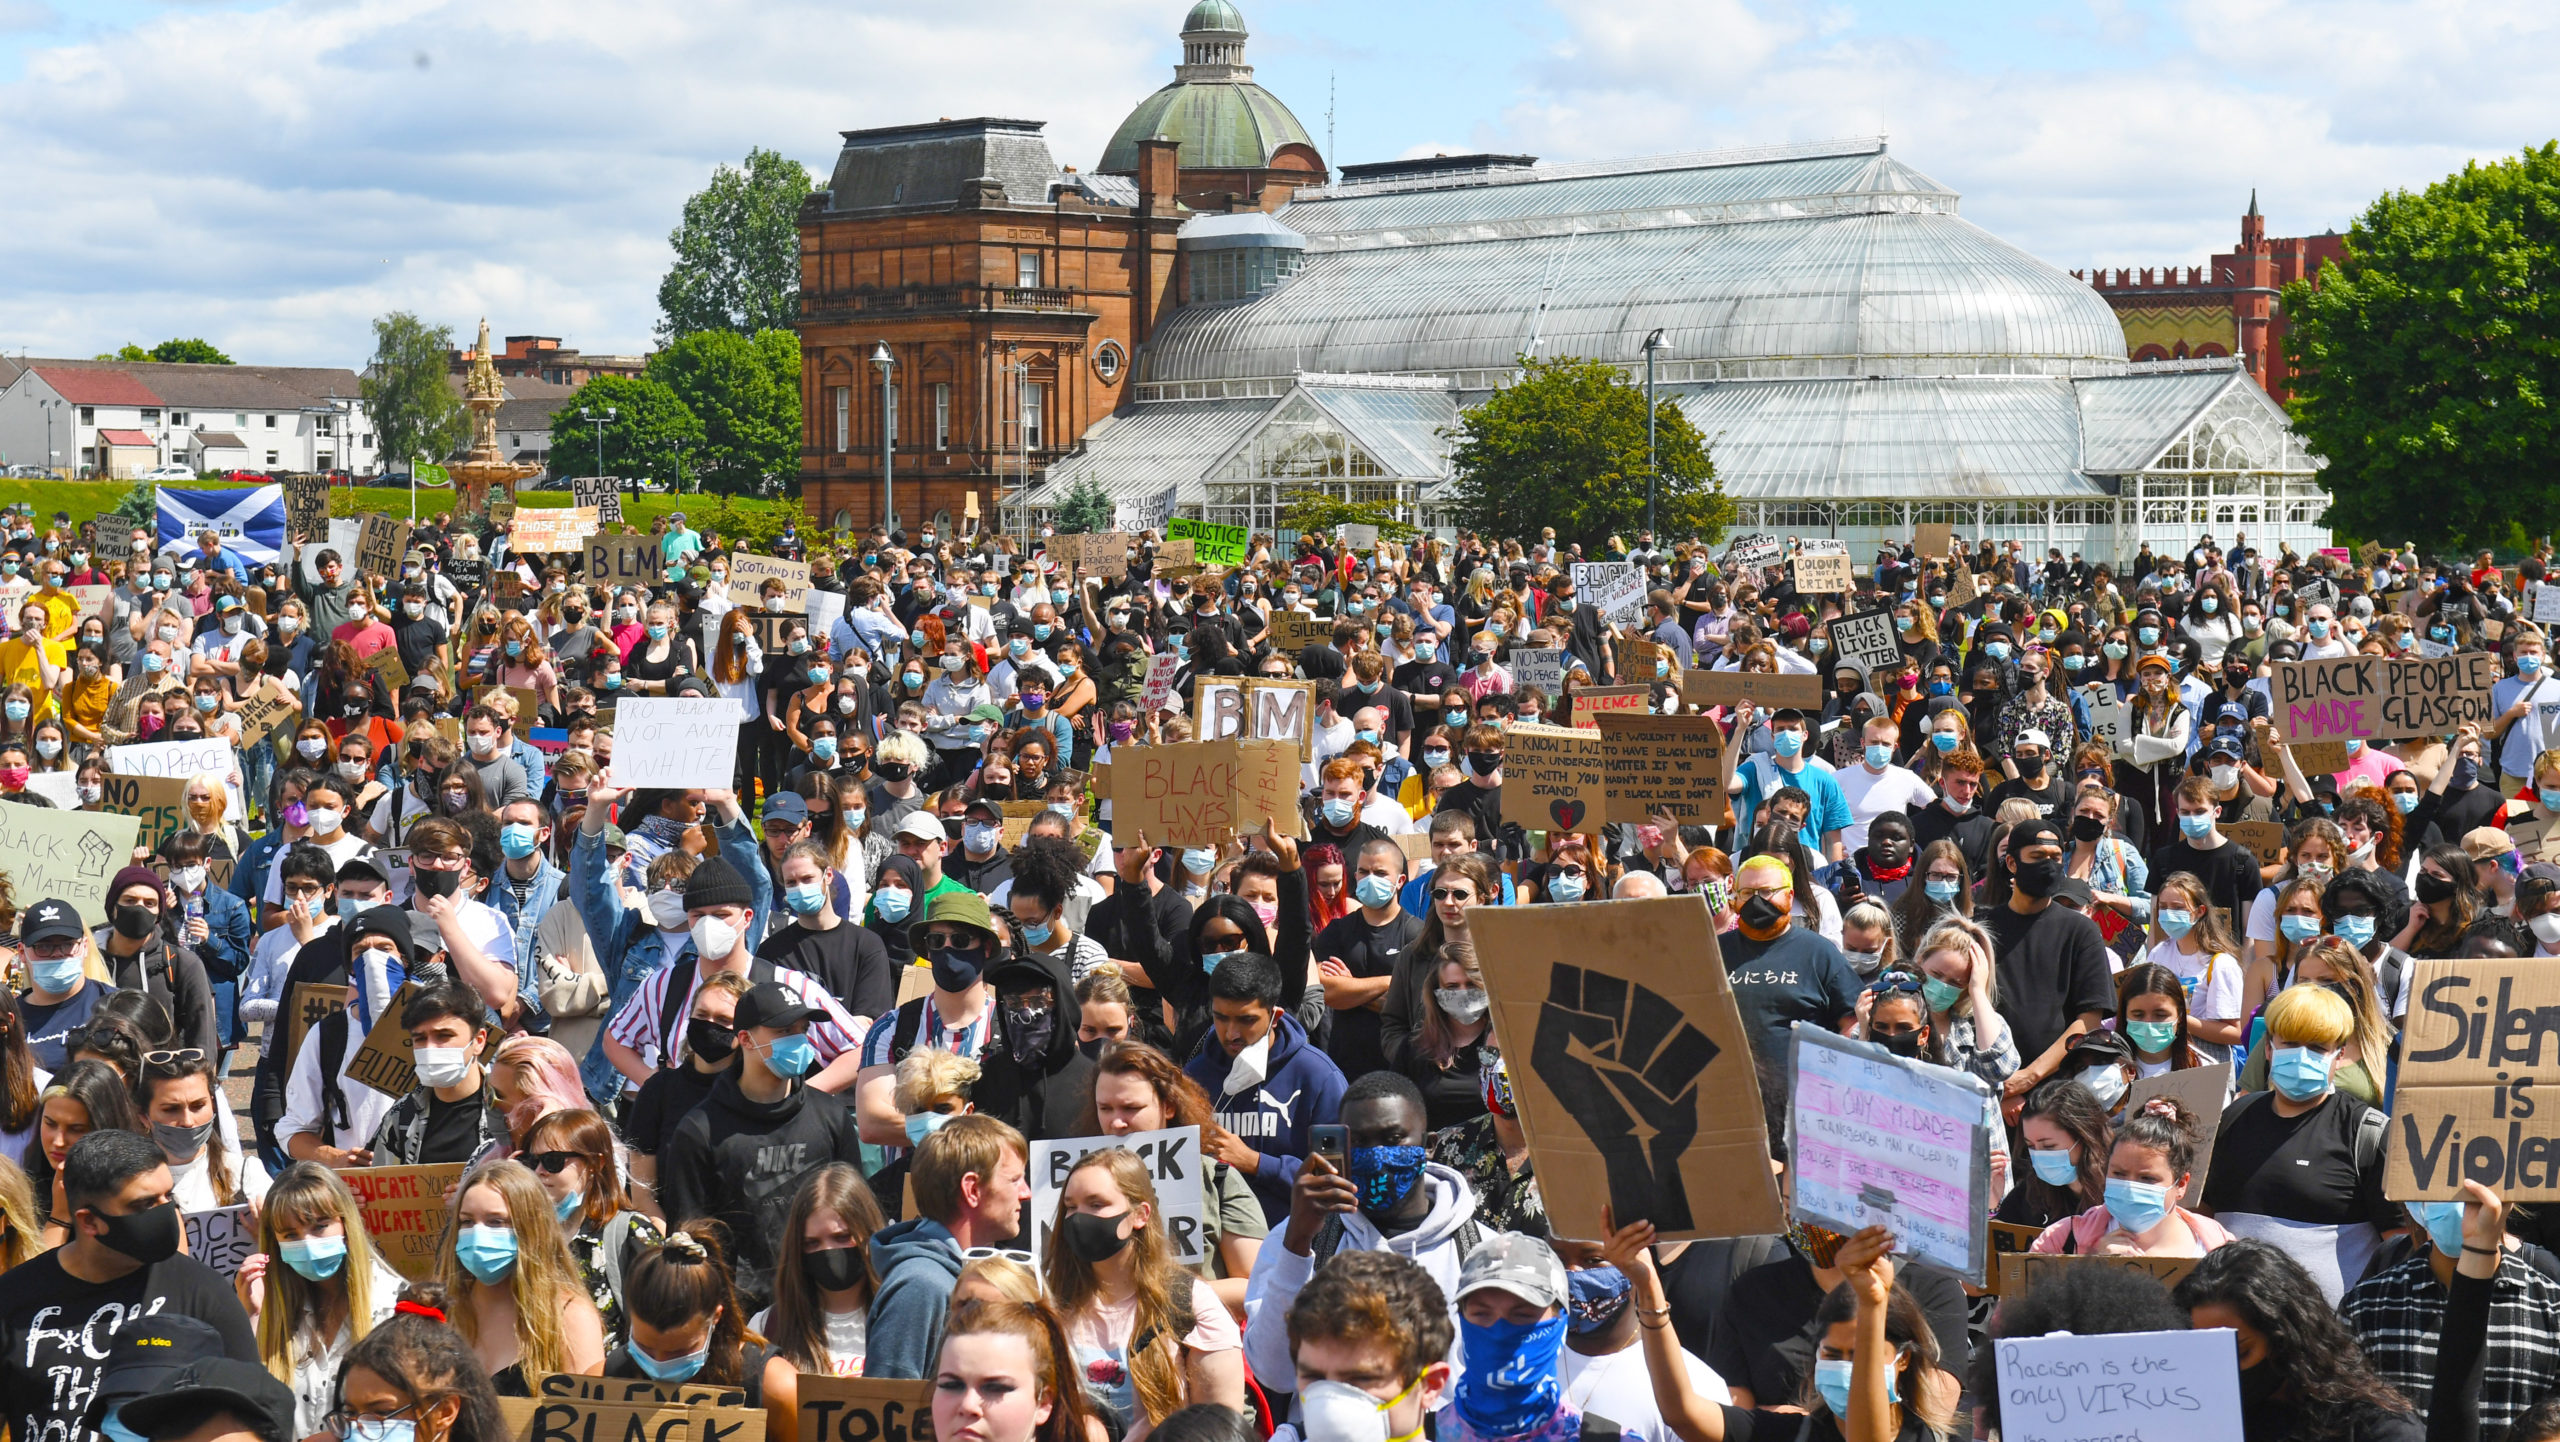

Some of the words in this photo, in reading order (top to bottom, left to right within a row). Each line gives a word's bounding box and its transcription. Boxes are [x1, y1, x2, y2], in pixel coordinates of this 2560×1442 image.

[575, 479, 620, 495] BLACK
[577, 494, 618, 507] LIVES
[1118, 486, 1177, 509] #SOLIDARITY
[97, 514, 129, 526] DADDY
[1119, 509, 1176, 532] SCOTLAND
[1138, 504, 1166, 520] FROM
[96, 525, 130, 536] CHANGED
[368, 516, 399, 542] BLACK
[517, 521, 555, 532] THOSE
[561, 521, 572, 531] IT
[575, 520, 595, 531] WAS
[1173, 523, 1187, 533] NO
[1187, 522, 1247, 545] JUSTICE
[104, 535, 119, 543] THE
[366, 536, 394, 556] LIVES
[525, 542, 545, 551] TO
[1085, 534, 1116, 546] RACISM
[1736, 536, 1776, 551] RACISM
[1804, 541, 1815, 550] WE
[1820, 541, 1844, 550] STAND
[96, 542, 130, 557] WORLD
[1085, 547, 1093, 556] IS
[1097, 546, 1103, 555] A
[1195, 542, 1234, 564] PEACE
[1739, 550, 1780, 565] PANDEMIC
[449, 560, 478, 568] RACISM
[592, 545, 659, 580] BLM
[1085, 555, 1124, 566] PANDEMIC
[1797, 558, 1841, 571] COLOUR
[734, 559, 789, 579] SCOTLAND
[791, 568, 804, 580] IS
[1095, 566, 1114, 576] TOO
[1576, 564, 1629, 587] BLACK
[1618, 568, 1643, 587] SILENCE
[731, 580, 751, 592] NOT
[1611, 579, 1643, 601] VIOLENCE
[1799, 577, 1845, 590] CRIME
[2301, 582, 2321, 594] BLACK
[1271, 612, 1310, 623] BLACK
[1289, 622, 1334, 638] SILENCE
[1836, 616, 1884, 640] BLACK
[1840, 632, 1888, 655] LIVES
[1516, 651, 1531, 667] NO
[1534, 650, 1560, 664] JUSTICE
[1859, 647, 1899, 666] ATTER
[1517, 669, 1532, 683] NO
[1535, 669, 1559, 682] PEACE
[2283, 660, 2375, 704] BLACK
[2389, 657, 2489, 696] PEOPLE
[236, 694, 266, 721] BLACK
[619, 700, 655, 720] PRO
[676, 700, 717, 716] BLACK
[725, 702, 736, 713] IS
[1574, 694, 1640, 711] SILENCE
[2221, 703, 2239, 713] ATL
[1214, 688, 1306, 740] BM
[2289, 700, 2373, 737] MADE
[2383, 693, 2493, 730] GLASGOW
[615, 722, 675, 744] NOT
[685, 722, 738, 739] ANTI
[1603, 732, 1622, 743] WE
[1682, 733, 1709, 744] HAVE
[1505, 734, 1515, 749] I
[1523, 737, 1558, 752] KNOW
[1563, 740, 1572, 753] I
[1579, 741, 1601, 755] WI
[1603, 746, 1618, 757] TO
[1623, 747, 1649, 756] HAVE
[1657, 747, 1687, 758] BLACK
[1689, 747, 1718, 759] LIVES
[124, 753, 163, 777] NO
[166, 748, 225, 777] PEACE
[1505, 754, 1546, 766] NEVER
[1550, 754, 1603, 769] UNDERSTA
[1605, 759, 1648, 771] MATTER
[1652, 760, 1668, 771] IF
[1675, 760, 1692, 771] WE
[1145, 759, 1249, 799] BLACK
[1256, 742, 1282, 815] #BLM
[1504, 768, 1528, 780] BUT
[1534, 770, 1568, 783] WITH
[1577, 771, 1600, 784] YOU
[1605, 774, 1638, 786] HADN'T
[1643, 775, 1664, 786] HAD
[1668, 776, 1686, 786] 300
[1691, 776, 1718, 788] YEARS
[103, 778, 140, 807] NO
[1532, 785, 1578, 798] STAND!
[1606, 789, 1619, 799] OF
[1625, 788, 1653, 799] BLACK
[1656, 789, 1682, 800] LIVES
[1686, 789, 1713, 800] DON'T
[1160, 800, 1231, 826] LIVES
[1645, 802, 1700, 818] MATTER!
[2239, 829, 2265, 838] YOU
[1728, 970, 1799, 985] んにちは
[1818, 1050, 1838, 1066] SAY
[1863, 1062, 1883, 1080] HIS
[1909, 1073, 1937, 1094] NAME
[1820, 1083, 1874, 1125] TONY
[2493, 1072, 2535, 1119] is
[1800, 1114, 1809, 1131] A
[1816, 1119, 1880, 1147] TRANSGENDER
[1884, 1136, 1903, 1153] MAN
[1908, 1144, 1942, 1162] KILLED
[1946, 1157, 1959, 1171] BY
[756, 1143, 807, 1174] NIKE
[1848, 1162, 1867, 1176] SHOT
[1874, 1166, 1884, 1180] IN
[1889, 1170, 1906, 1187] THE
[1911, 1177, 1941, 1196] CHEST
[185, 1211, 251, 1250] ACK
[192, 1242, 253, 1270] VES
[136, 1339, 148, 1347] no
[150, 1337, 172, 1347] idea
[2002, 1344, 2089, 1379] Racism
[2102, 1358, 2120, 1376] is
[2131, 1356, 2177, 1375] the
[2011, 1385, 2068, 1424] only
[2077, 1382, 2201, 1414] VIRUS
[531, 1404, 744, 1442] BLACK
[802, 1400, 934, 1442] TOGE
